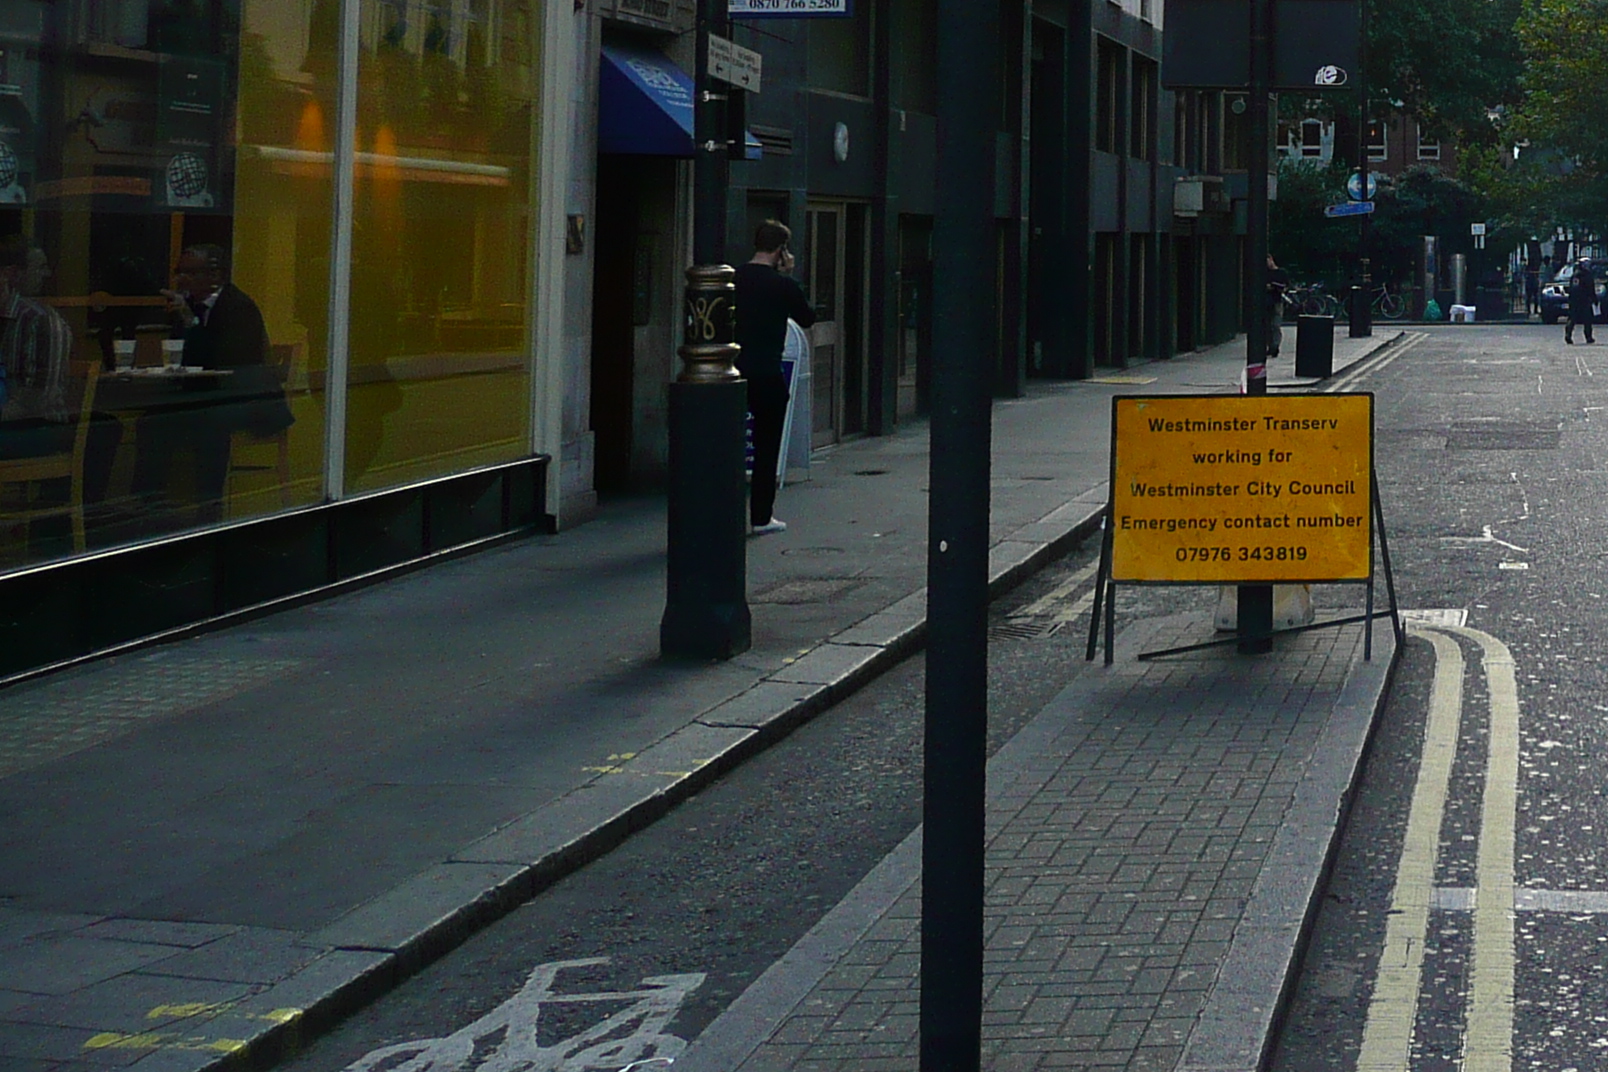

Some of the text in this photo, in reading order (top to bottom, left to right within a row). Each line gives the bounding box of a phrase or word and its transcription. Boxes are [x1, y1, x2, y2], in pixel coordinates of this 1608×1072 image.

[1148, 416, 1339, 432] Westminster Transerv
[1192, 448, 1293, 465] working for
[1131, 480, 1356, 497] Westminster City Council
[1121, 513, 1363, 531] Emergency contact number
[1175, 546, 1308, 562] 07976 343819
